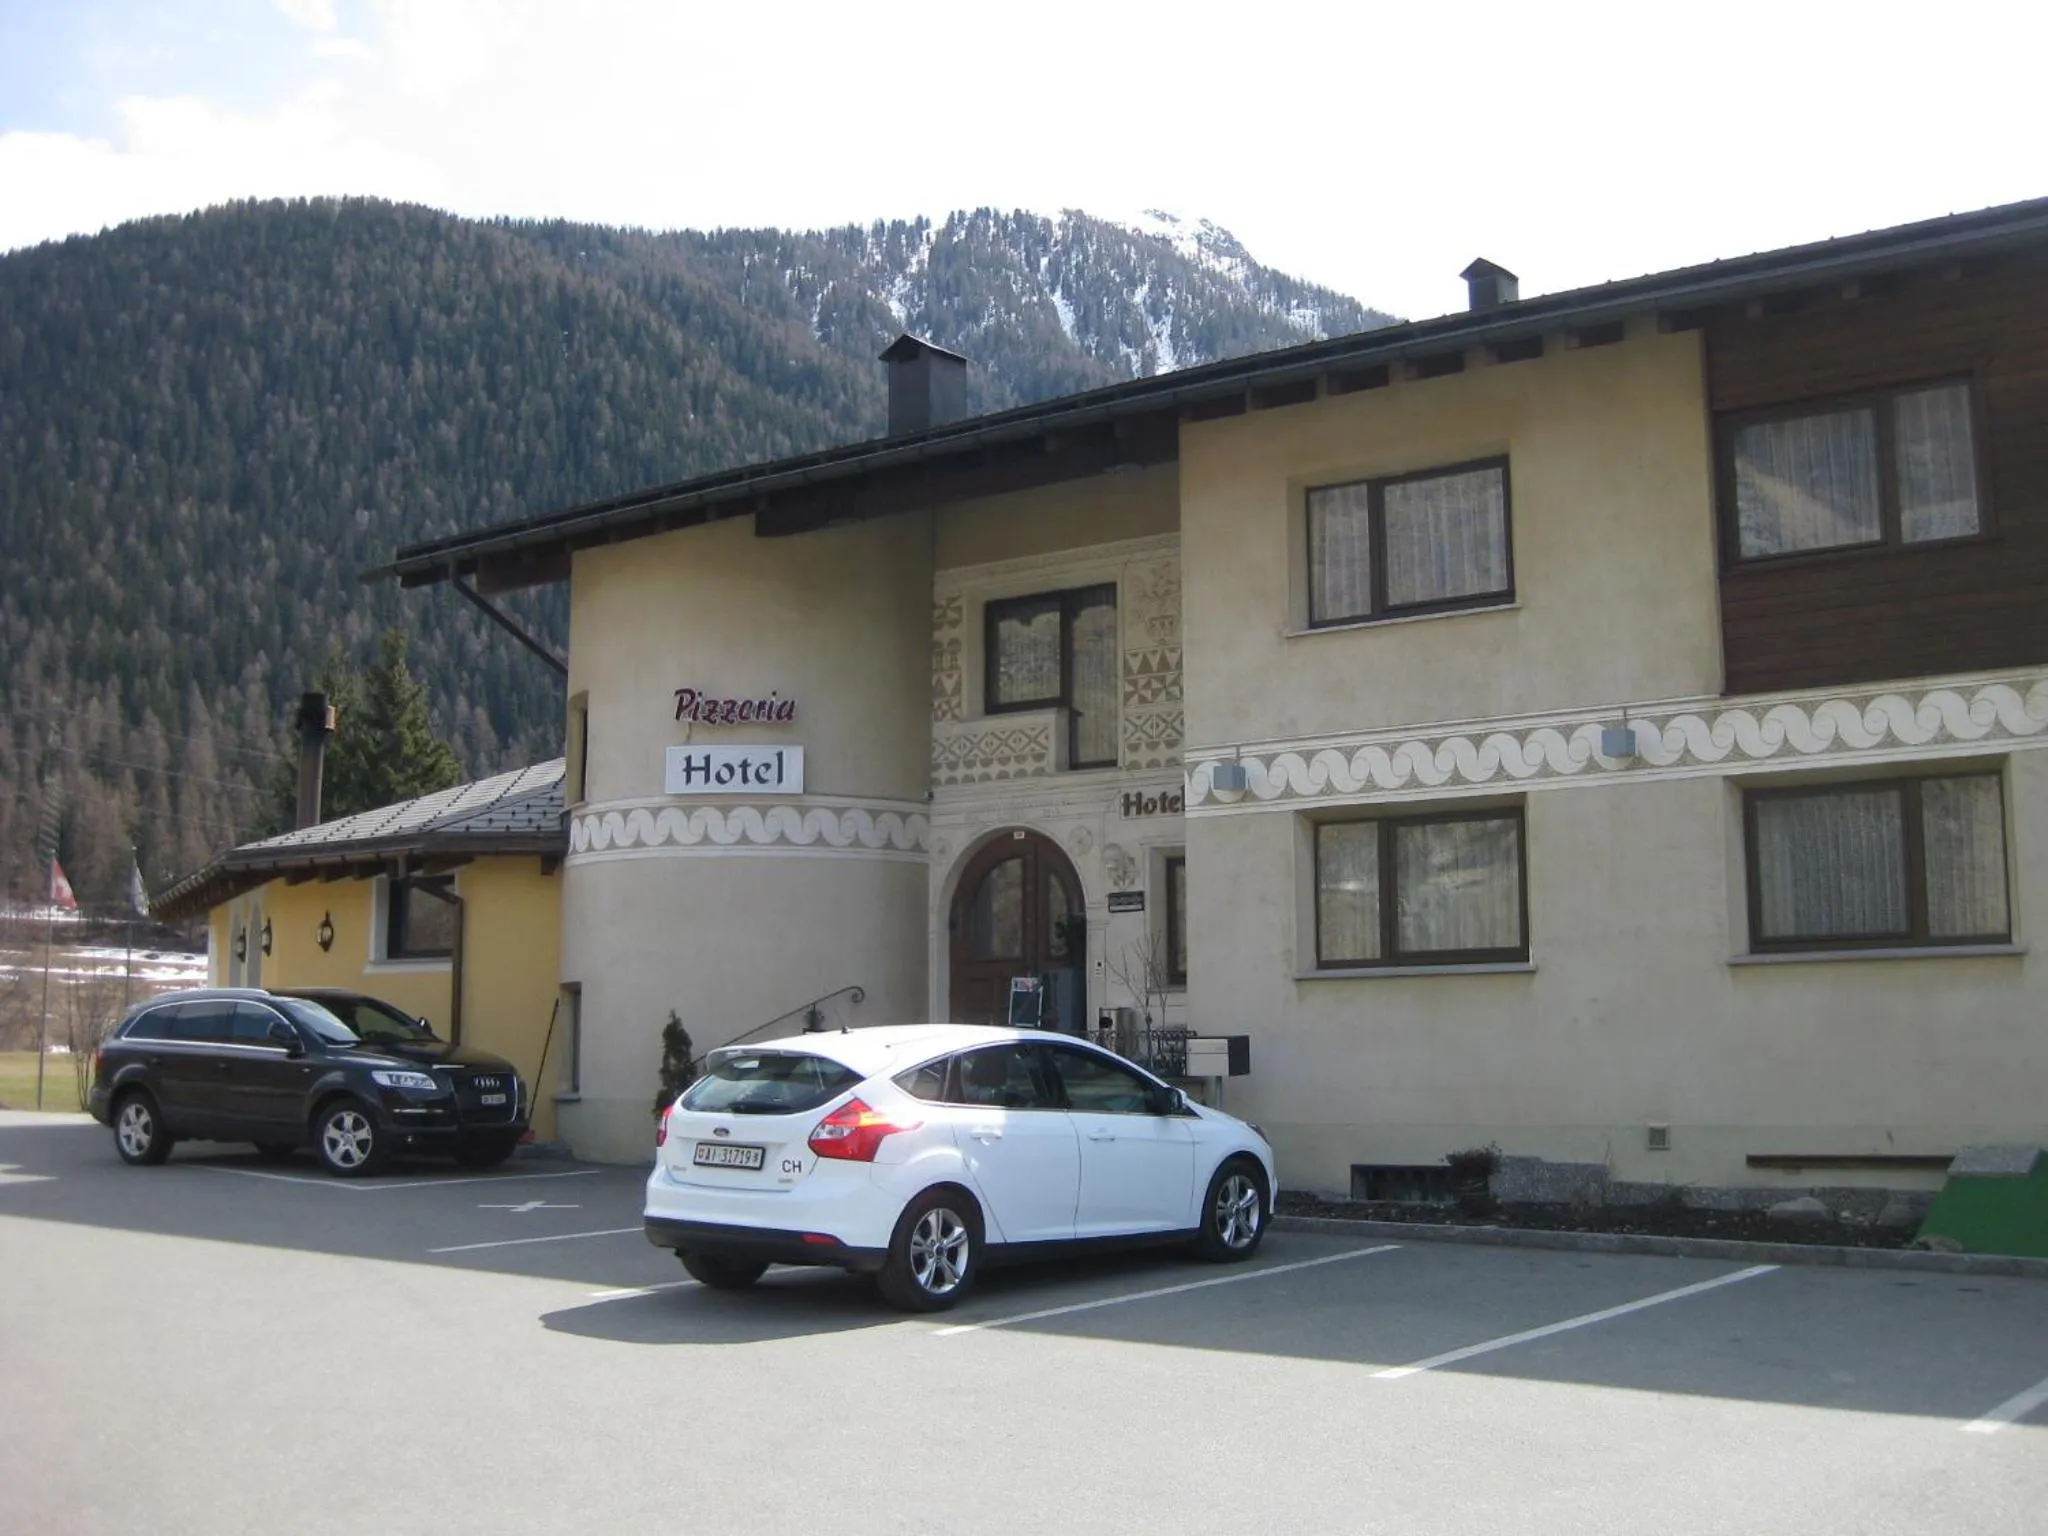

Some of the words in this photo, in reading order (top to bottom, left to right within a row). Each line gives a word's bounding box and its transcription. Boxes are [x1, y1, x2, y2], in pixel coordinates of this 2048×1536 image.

[674, 688, 796, 724] Pizzeria
[683, 751, 784, 785] Hotel
[1122, 784, 1185, 816] Hotel
[782, 1160, 802, 1173] CH
